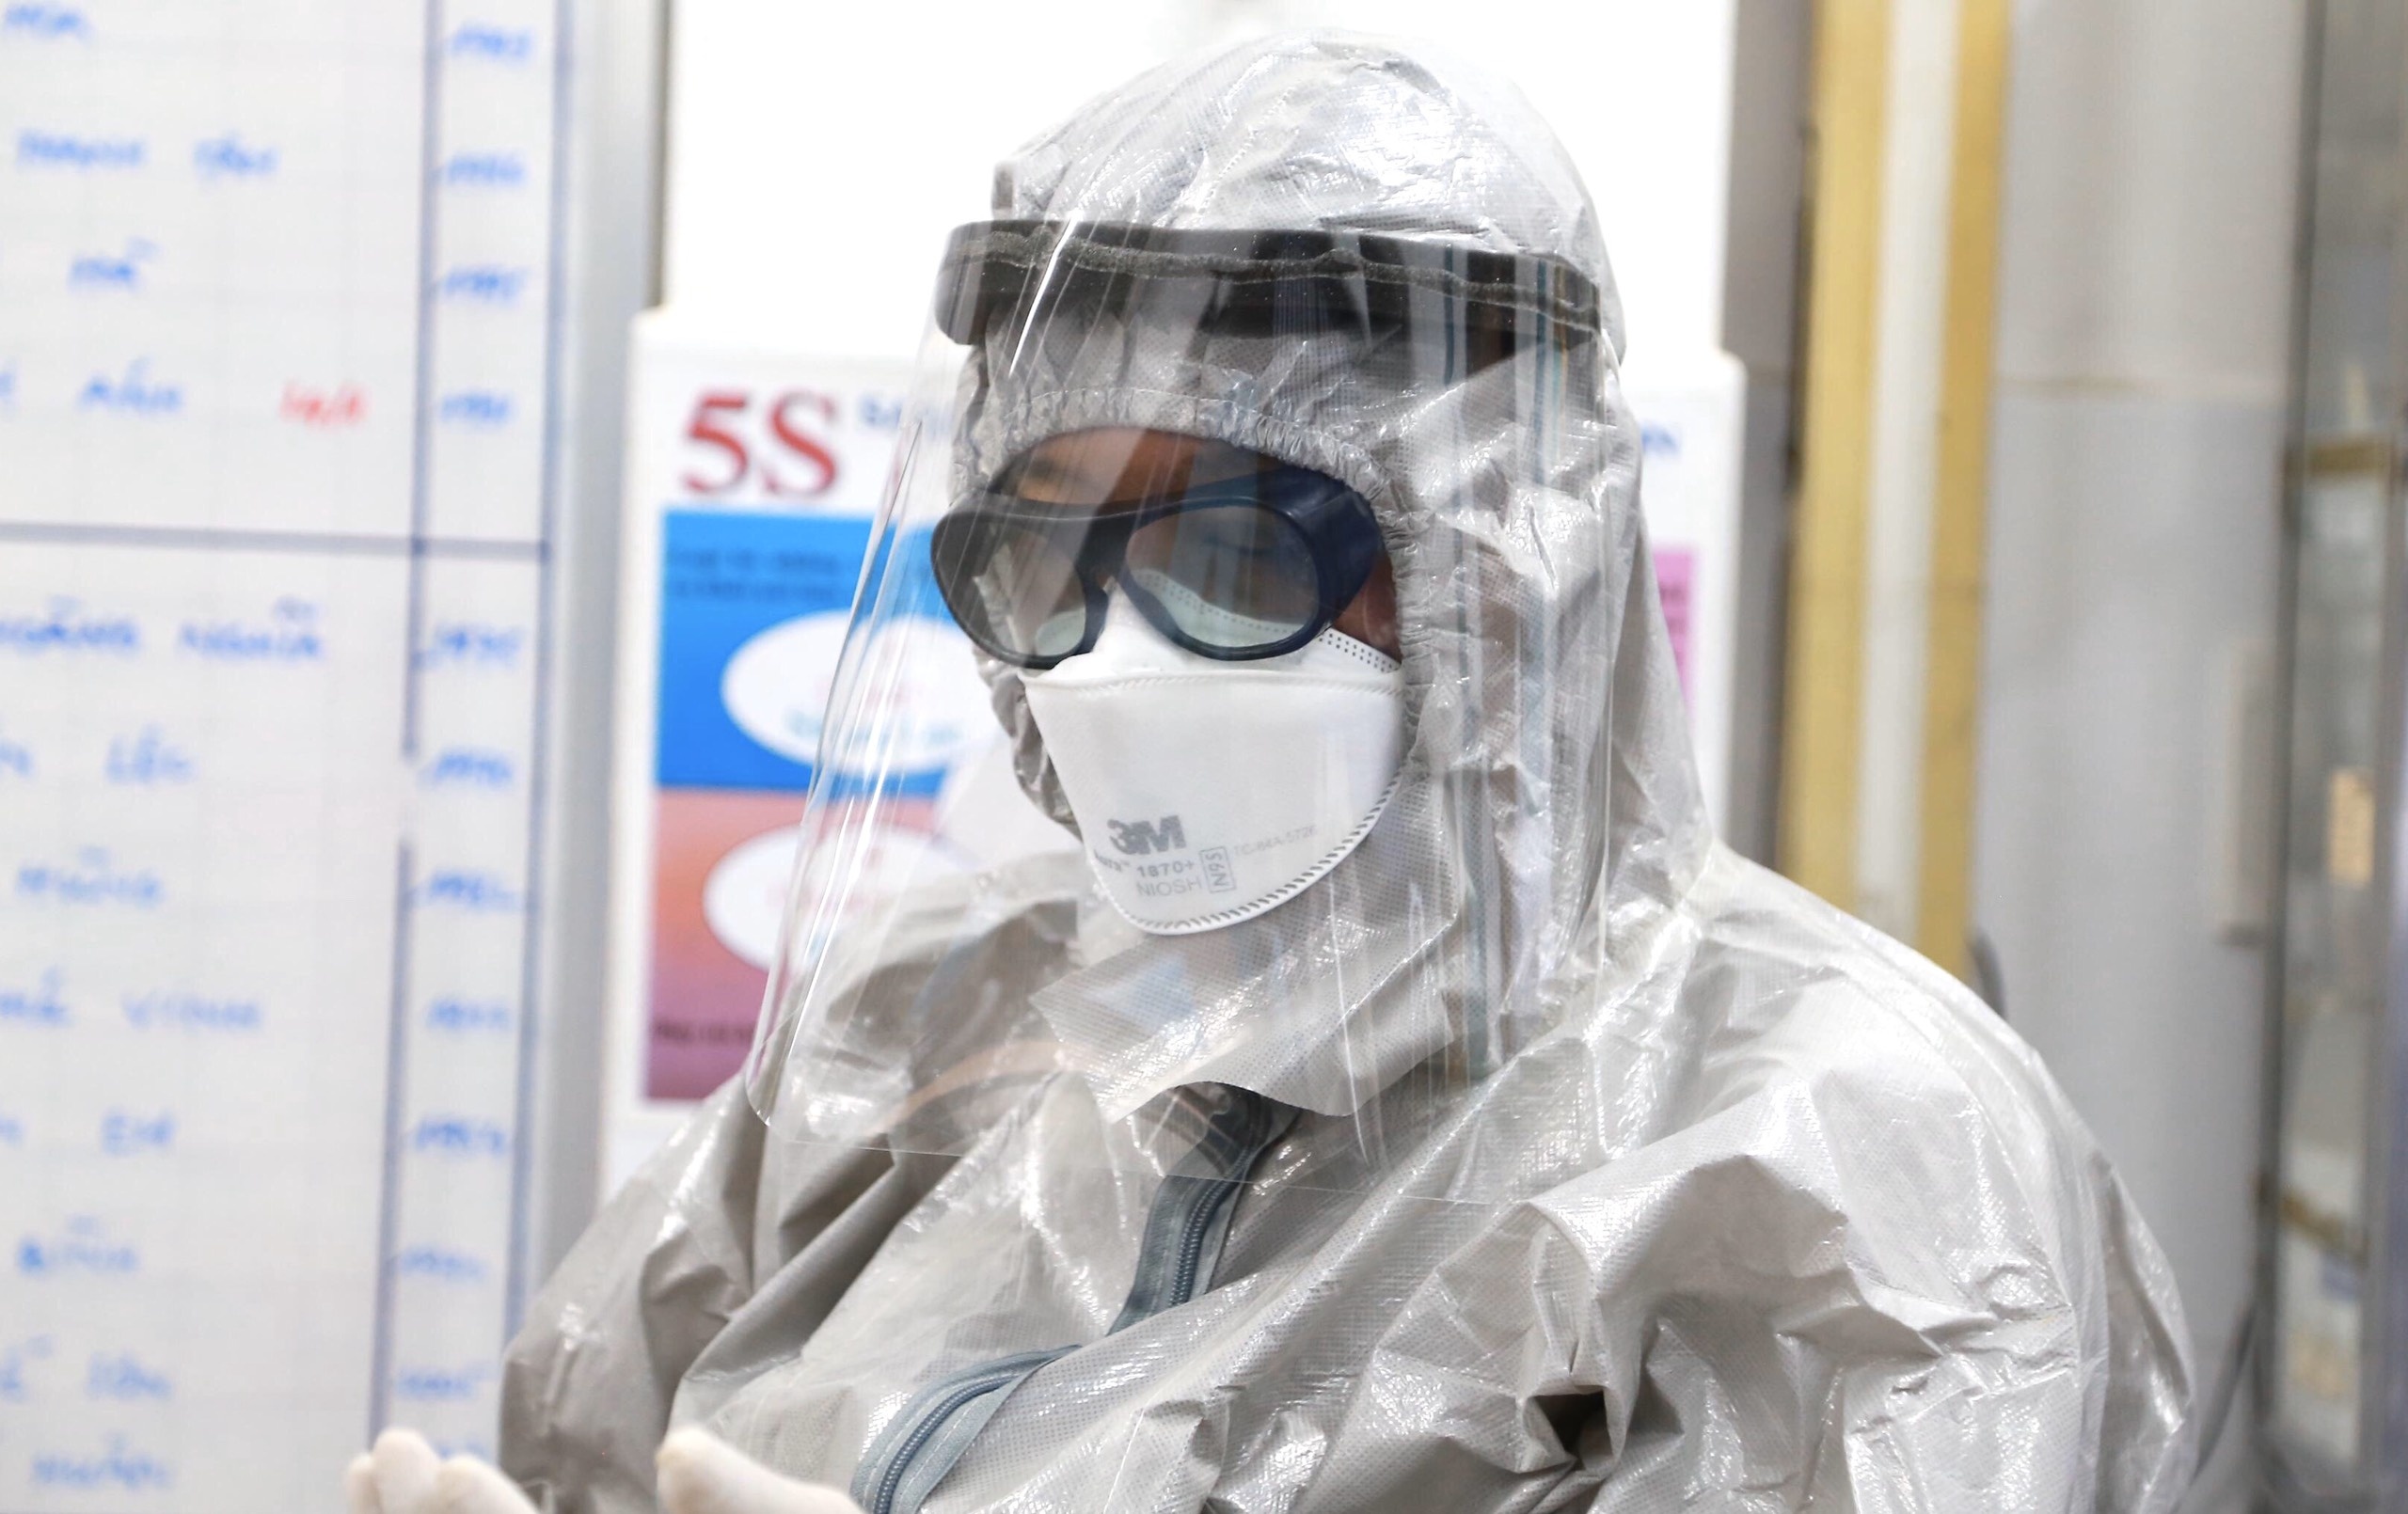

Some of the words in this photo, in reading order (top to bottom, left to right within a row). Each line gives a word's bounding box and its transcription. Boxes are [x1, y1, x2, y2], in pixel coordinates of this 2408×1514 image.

[682, 387, 839, 497] 5S
[1107, 814, 1186, 855] 3M
[1136, 859, 1195, 878] 1870+
[1206, 852, 1227, 886] N95
[1136, 875, 1202, 897] NIOSH
